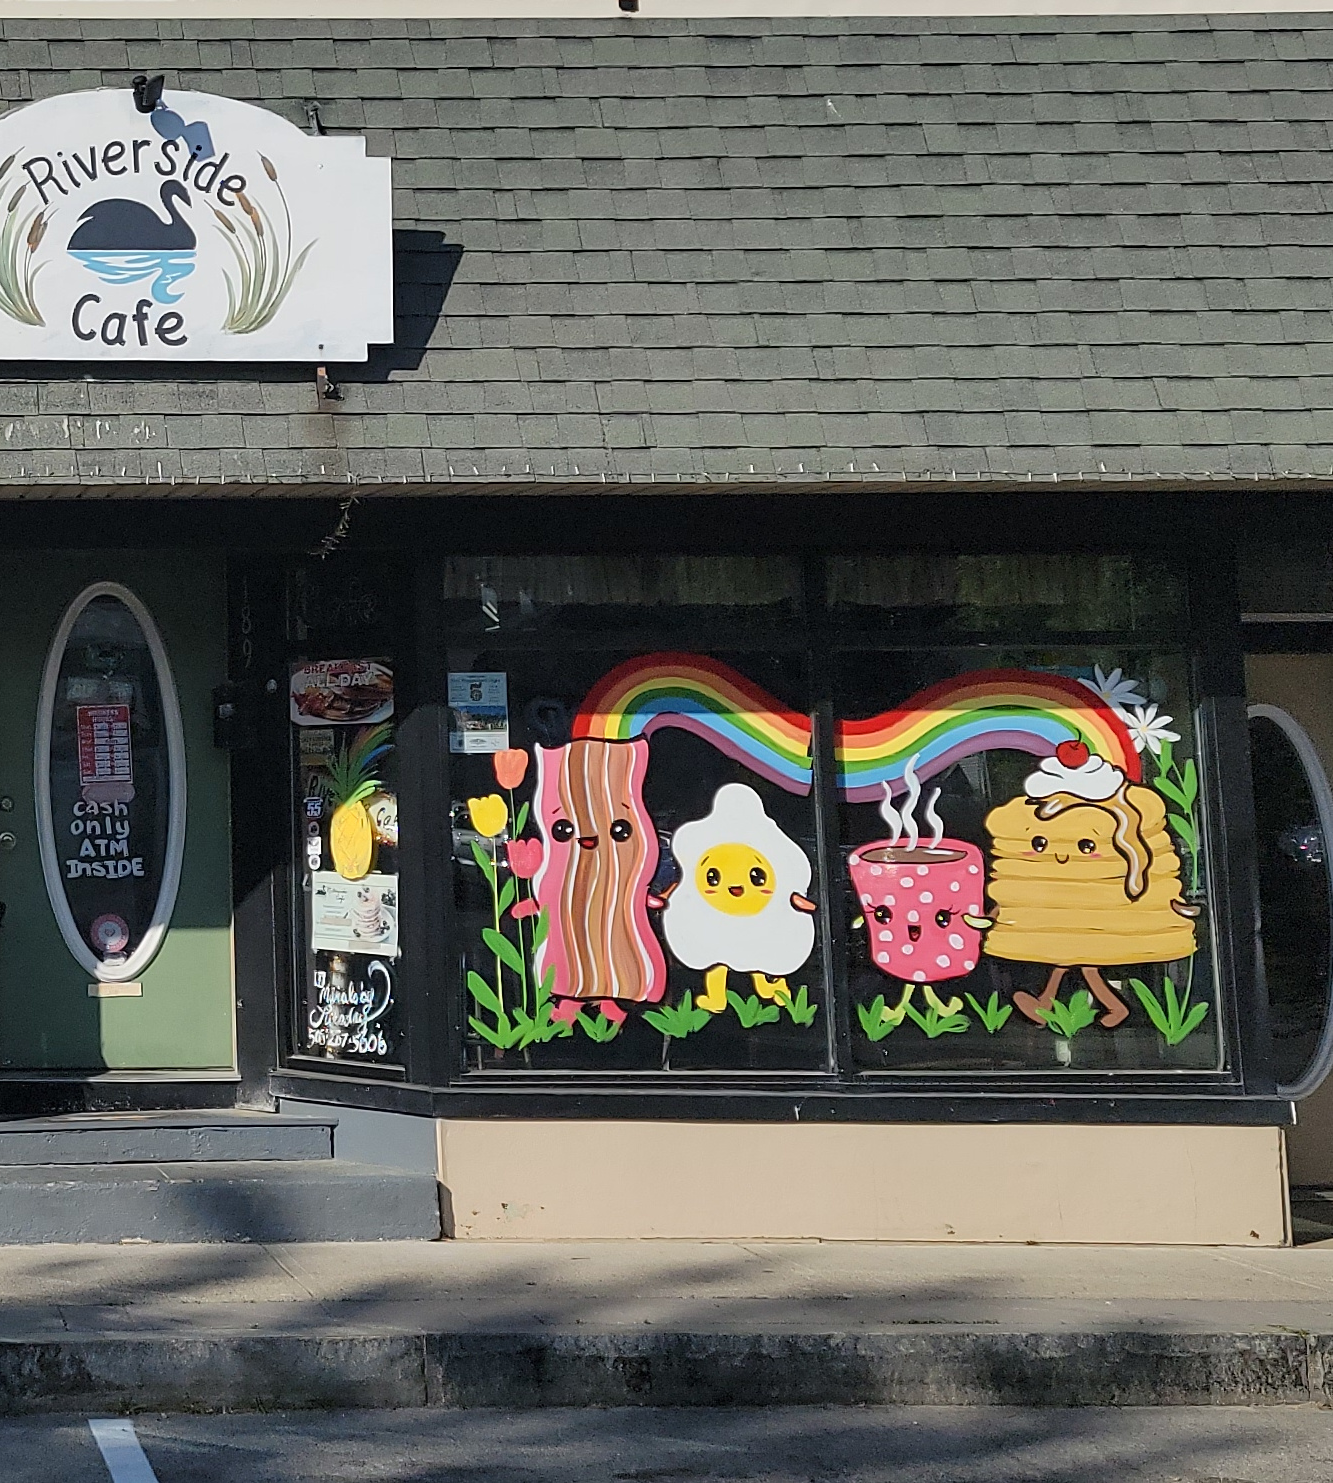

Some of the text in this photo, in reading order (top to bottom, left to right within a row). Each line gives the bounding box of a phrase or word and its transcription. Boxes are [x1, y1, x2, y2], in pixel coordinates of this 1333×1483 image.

[22, 138, 248, 206] Riverside
[71, 293, 188, 347] Cafe
[341, 672, 373, 687] DAY
[306, 802, 322, 817] 55
[79, 837, 130, 857] ATM
